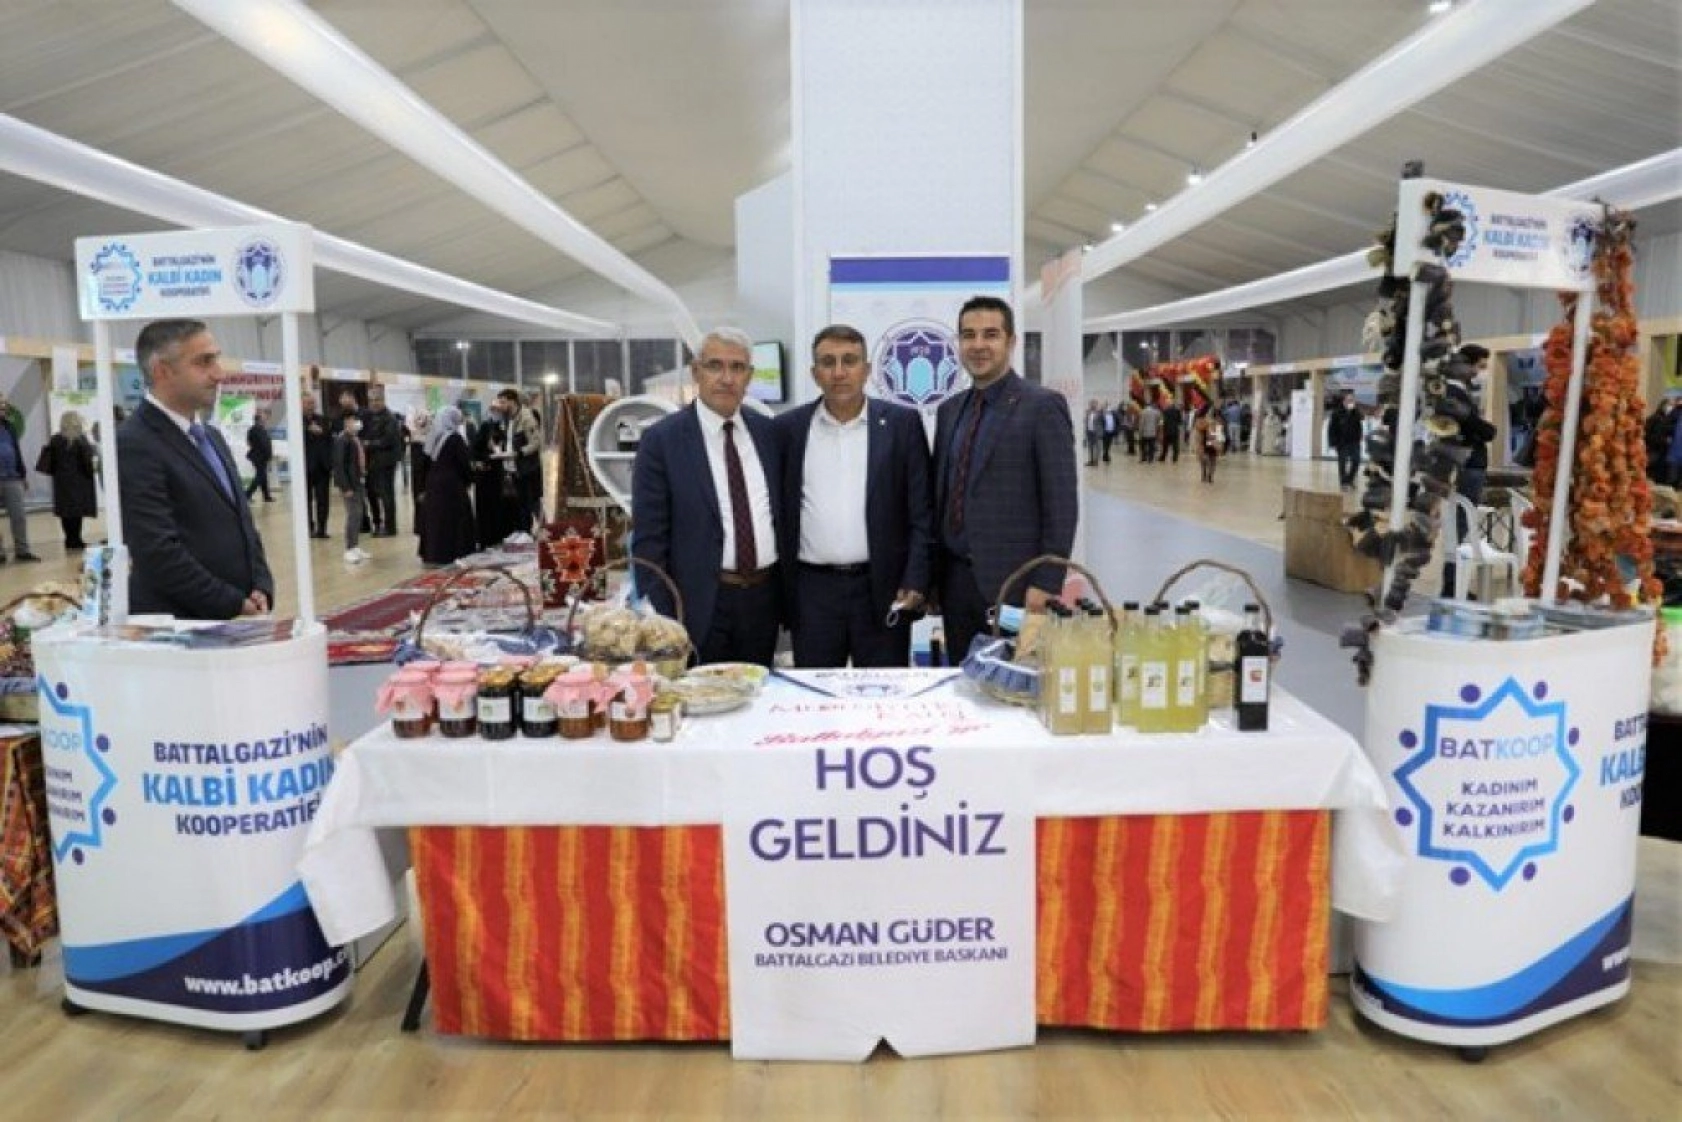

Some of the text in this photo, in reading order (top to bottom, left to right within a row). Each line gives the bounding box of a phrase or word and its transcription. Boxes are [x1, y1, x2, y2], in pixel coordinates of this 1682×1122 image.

[152, 723, 328, 765] BATTALGAZİ'NİN
[1440, 735, 1555, 760] BATKOOP
[142, 767, 237, 807] KALBİ
[814, 746, 937, 799] HOŞ
[1461, 778, 1538, 796] KADINIM
[1446, 799, 1545, 817] KAZANIRIM
[749, 801, 1006, 861] GELDİNİZ
[1443, 819, 1545, 839] KALKINIRIM
[764, 917, 995, 947] OSMAN GÜDER
